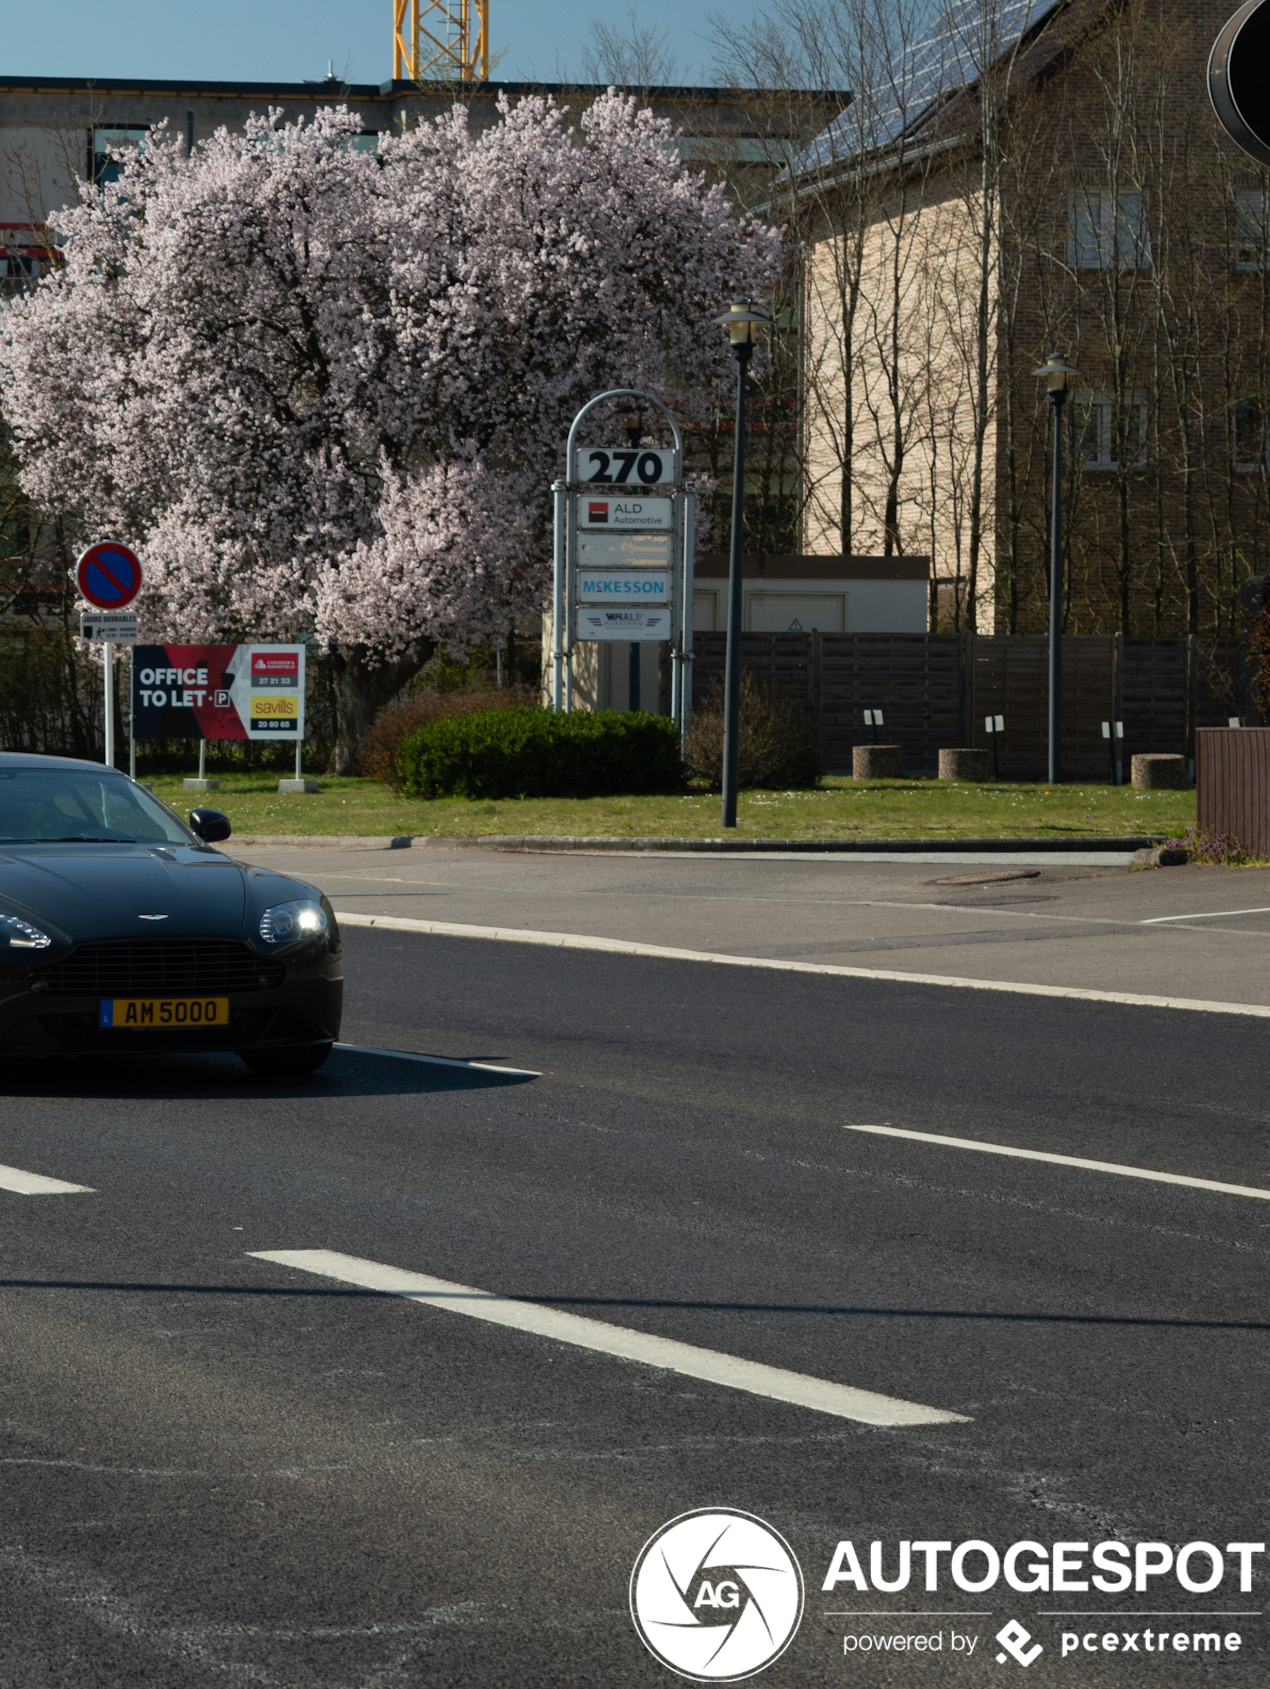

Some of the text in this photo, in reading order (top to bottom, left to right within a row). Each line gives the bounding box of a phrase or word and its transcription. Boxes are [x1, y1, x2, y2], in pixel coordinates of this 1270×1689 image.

[587, 452, 663, 484] 270
[614, 503, 642, 514] ALD
[614, 515, 662, 525] Automotive
[83, 615, 137, 623] JOURS OUVRABLES
[605, 612, 643, 622] WHALE
[139, 668, 208, 685] OFFICE
[280, 677, 291, 685] 33
[139, 690, 167, 707] TO
[171, 690, 207, 707] LET
[255, 699, 294, 714] savills
[125, 1002, 154, 1024] AM
[159, 1001, 217, 1023] 5000
